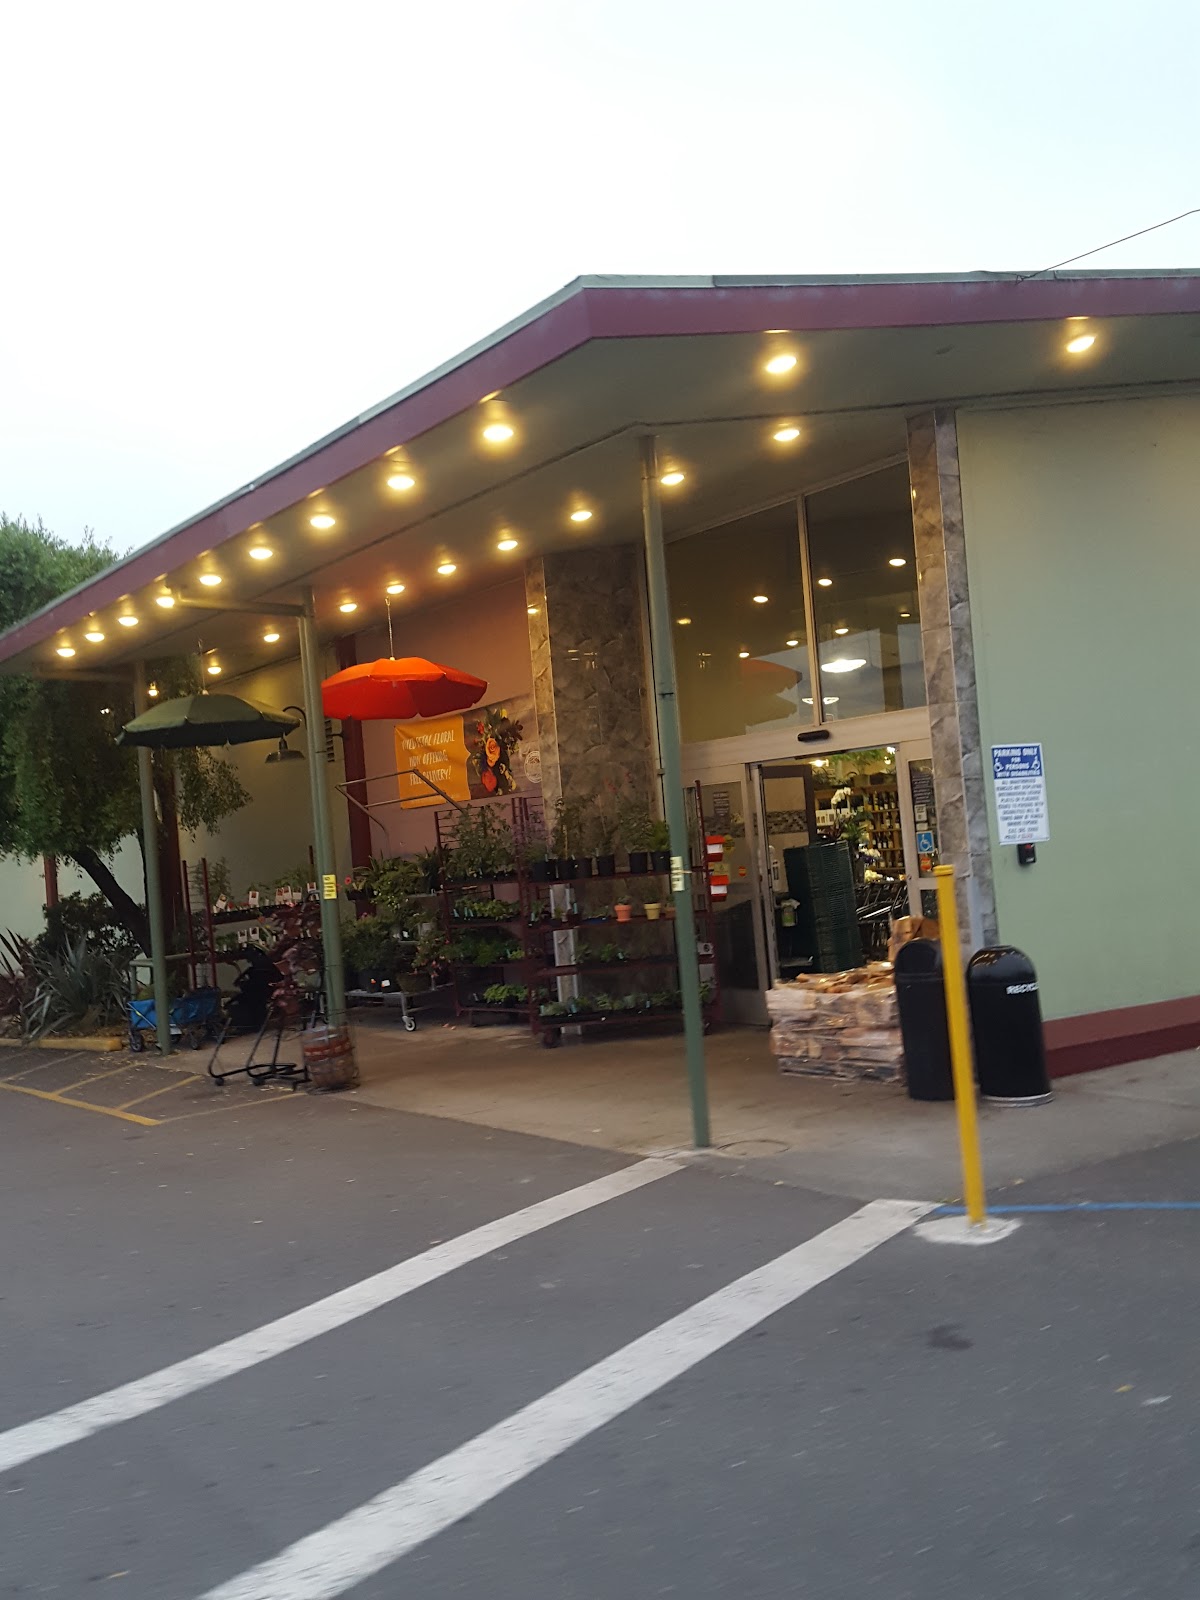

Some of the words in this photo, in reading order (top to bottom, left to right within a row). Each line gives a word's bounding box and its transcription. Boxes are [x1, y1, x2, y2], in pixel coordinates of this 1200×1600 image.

[433, 730, 455, 745] FLORAL
[993, 748, 1021, 758] PARKING
[1022, 747, 1038, 756] ONLY
[1005, 762, 1030, 770] PERSONS
[1010, 769, 1041, 777] DISABILITIES
